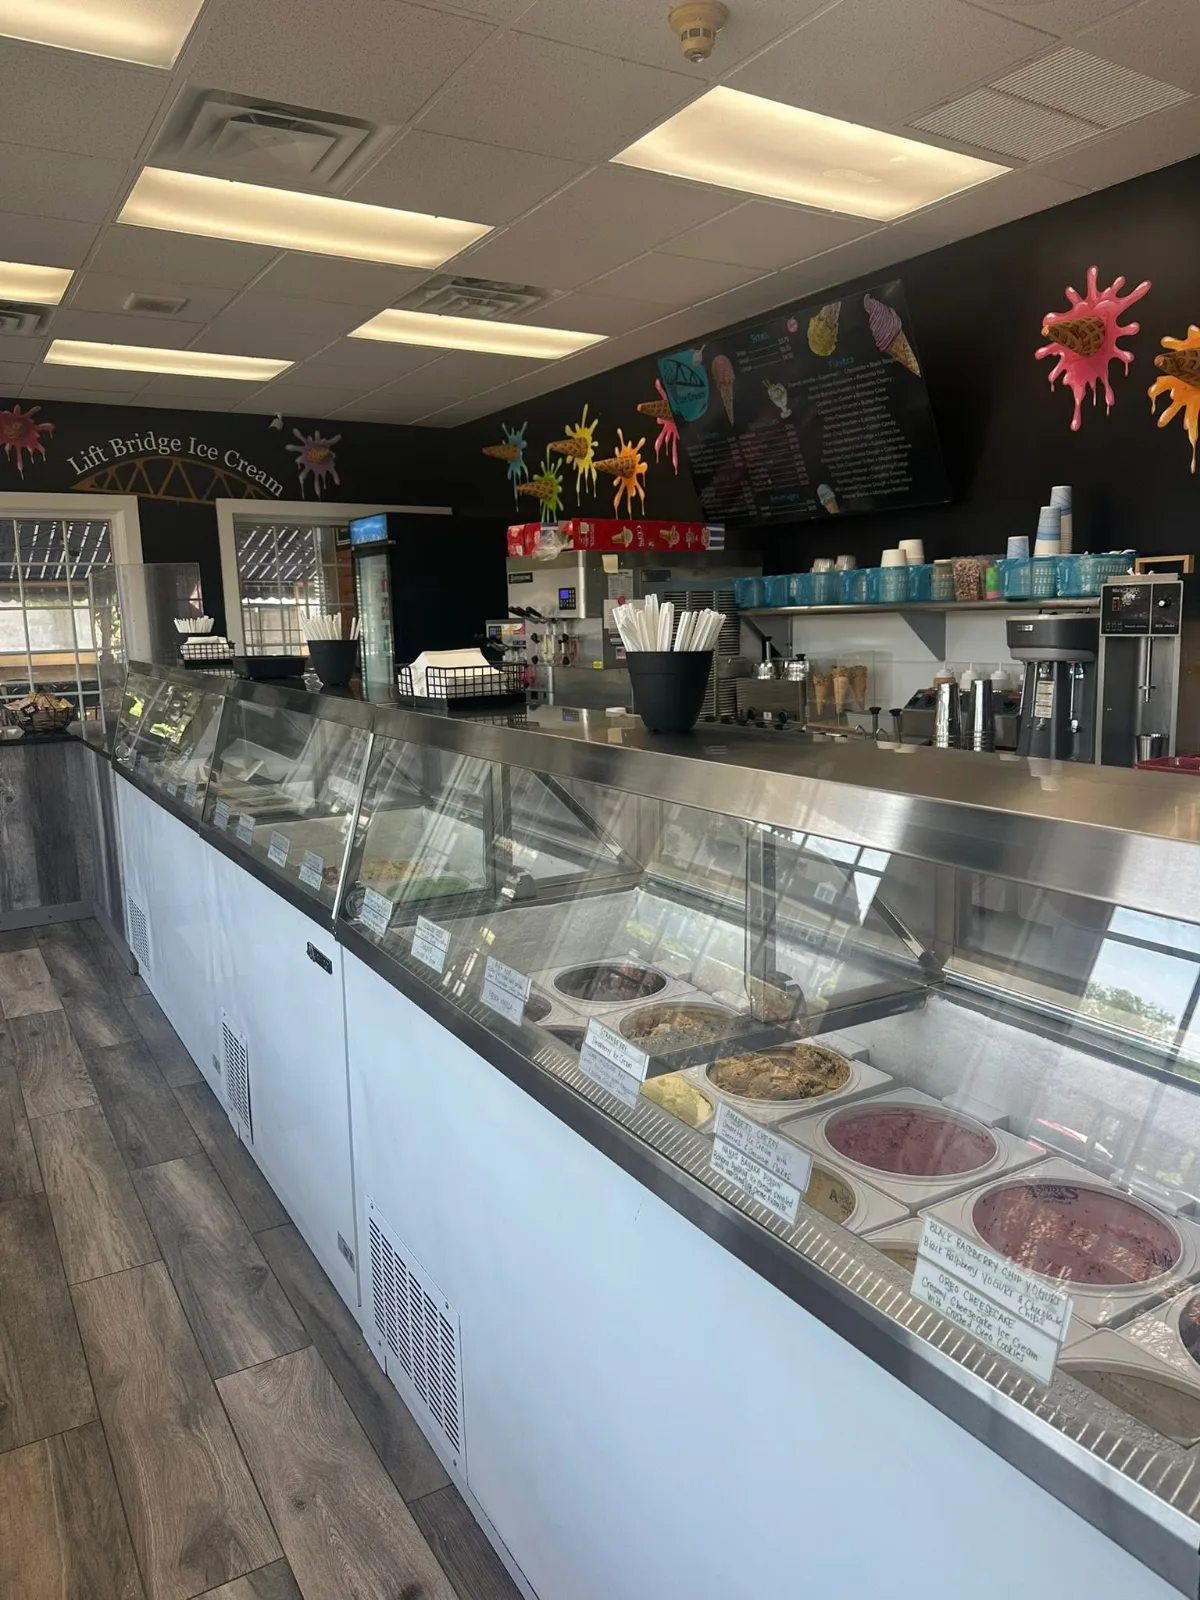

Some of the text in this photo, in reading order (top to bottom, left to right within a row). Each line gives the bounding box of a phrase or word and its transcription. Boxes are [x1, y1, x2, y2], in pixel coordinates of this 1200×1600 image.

[828, 355, 856, 369] Flavors
[66, 431, 285, 498] Lift Bridge Ice Cream
[928, 1220, 1061, 1310] BLACK RASPBERRY CHIP YOGURT
[937, 1272, 1016, 1330] OREO CHEESECAKE
[949, 1294, 994, 1331] Cheesecake
[996, 1325, 1010, 1341] Ice
[1011, 1335, 1039, 1361] Cream
[975, 1323, 993, 1341] Oreo
[995, 1337, 1025, 1363] Cookies
